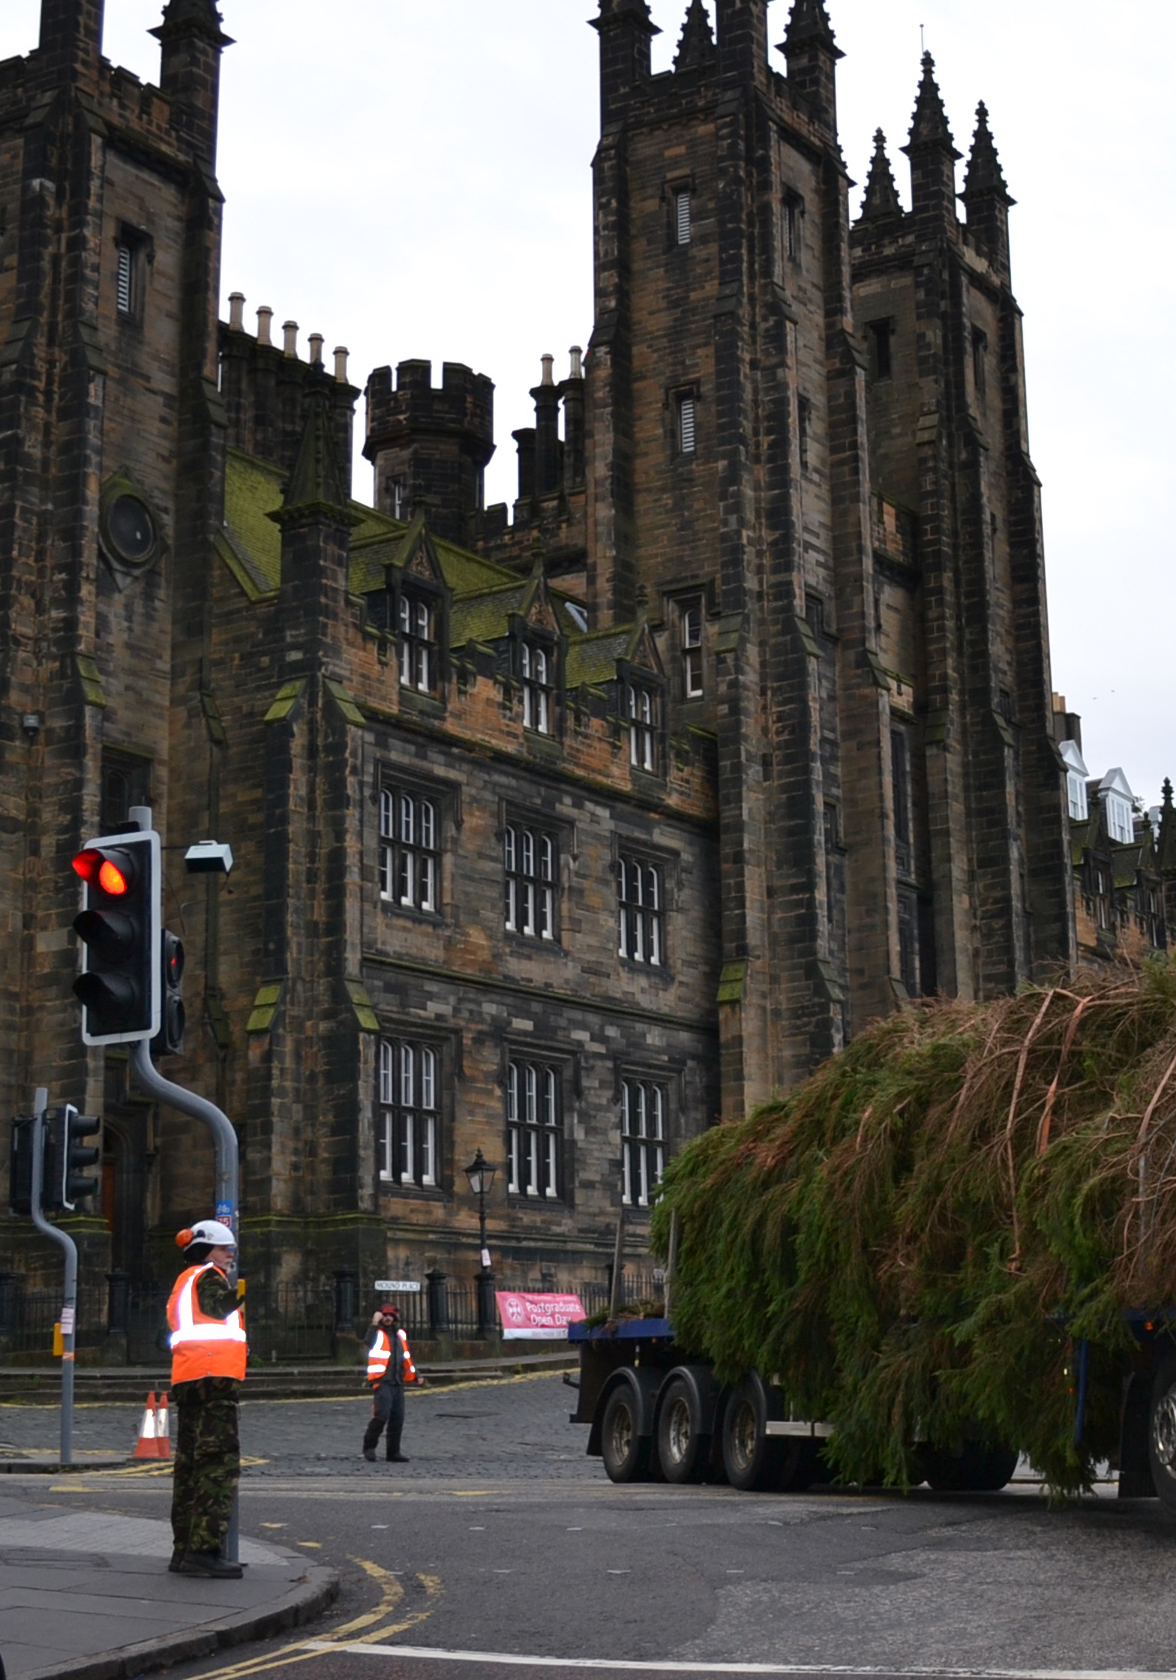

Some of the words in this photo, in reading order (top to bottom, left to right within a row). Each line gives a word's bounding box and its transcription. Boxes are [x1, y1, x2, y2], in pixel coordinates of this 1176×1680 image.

[525, 1301, 581, 1315] Postgraduate
[530, 1313, 554, 1328] Open
[554, 1314, 571, 1325] Day
